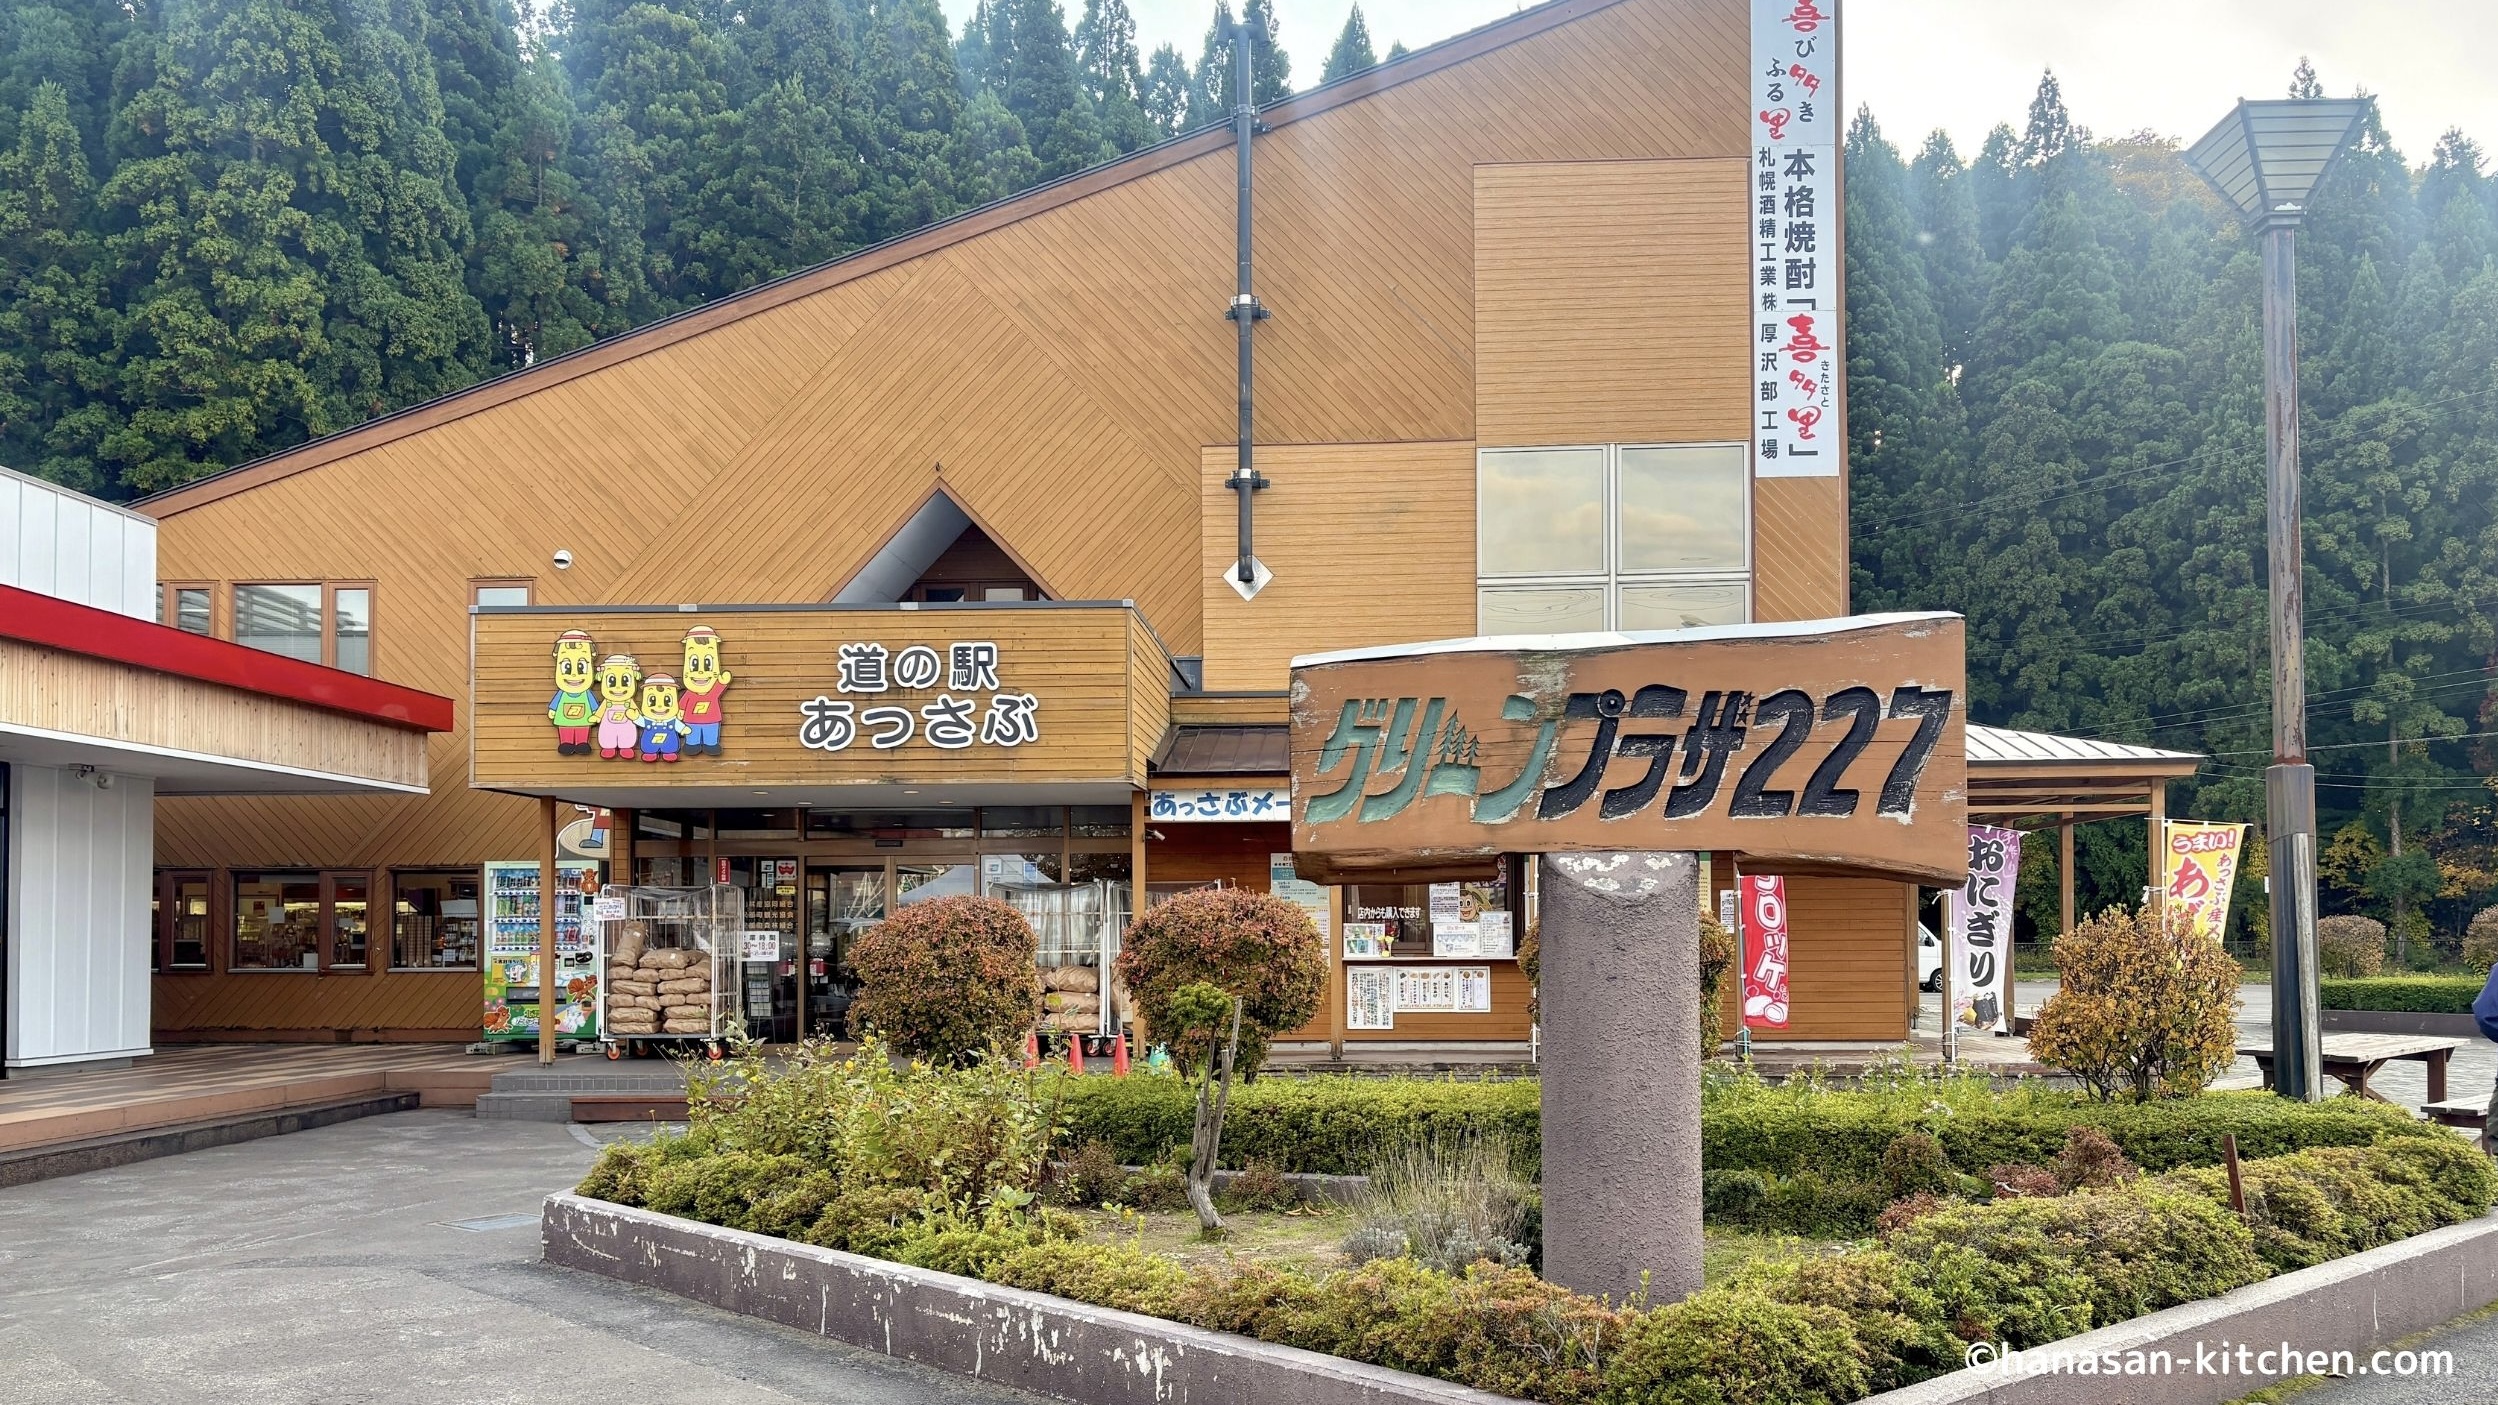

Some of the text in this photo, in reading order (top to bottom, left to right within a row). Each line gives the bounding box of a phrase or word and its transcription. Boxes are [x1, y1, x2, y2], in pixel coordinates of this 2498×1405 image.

[837, 642, 999, 693] 道の駅
[1357, 906, 1422, 920] 店内からも購入できます
[1966, 835, 2005, 988] おにぎり
